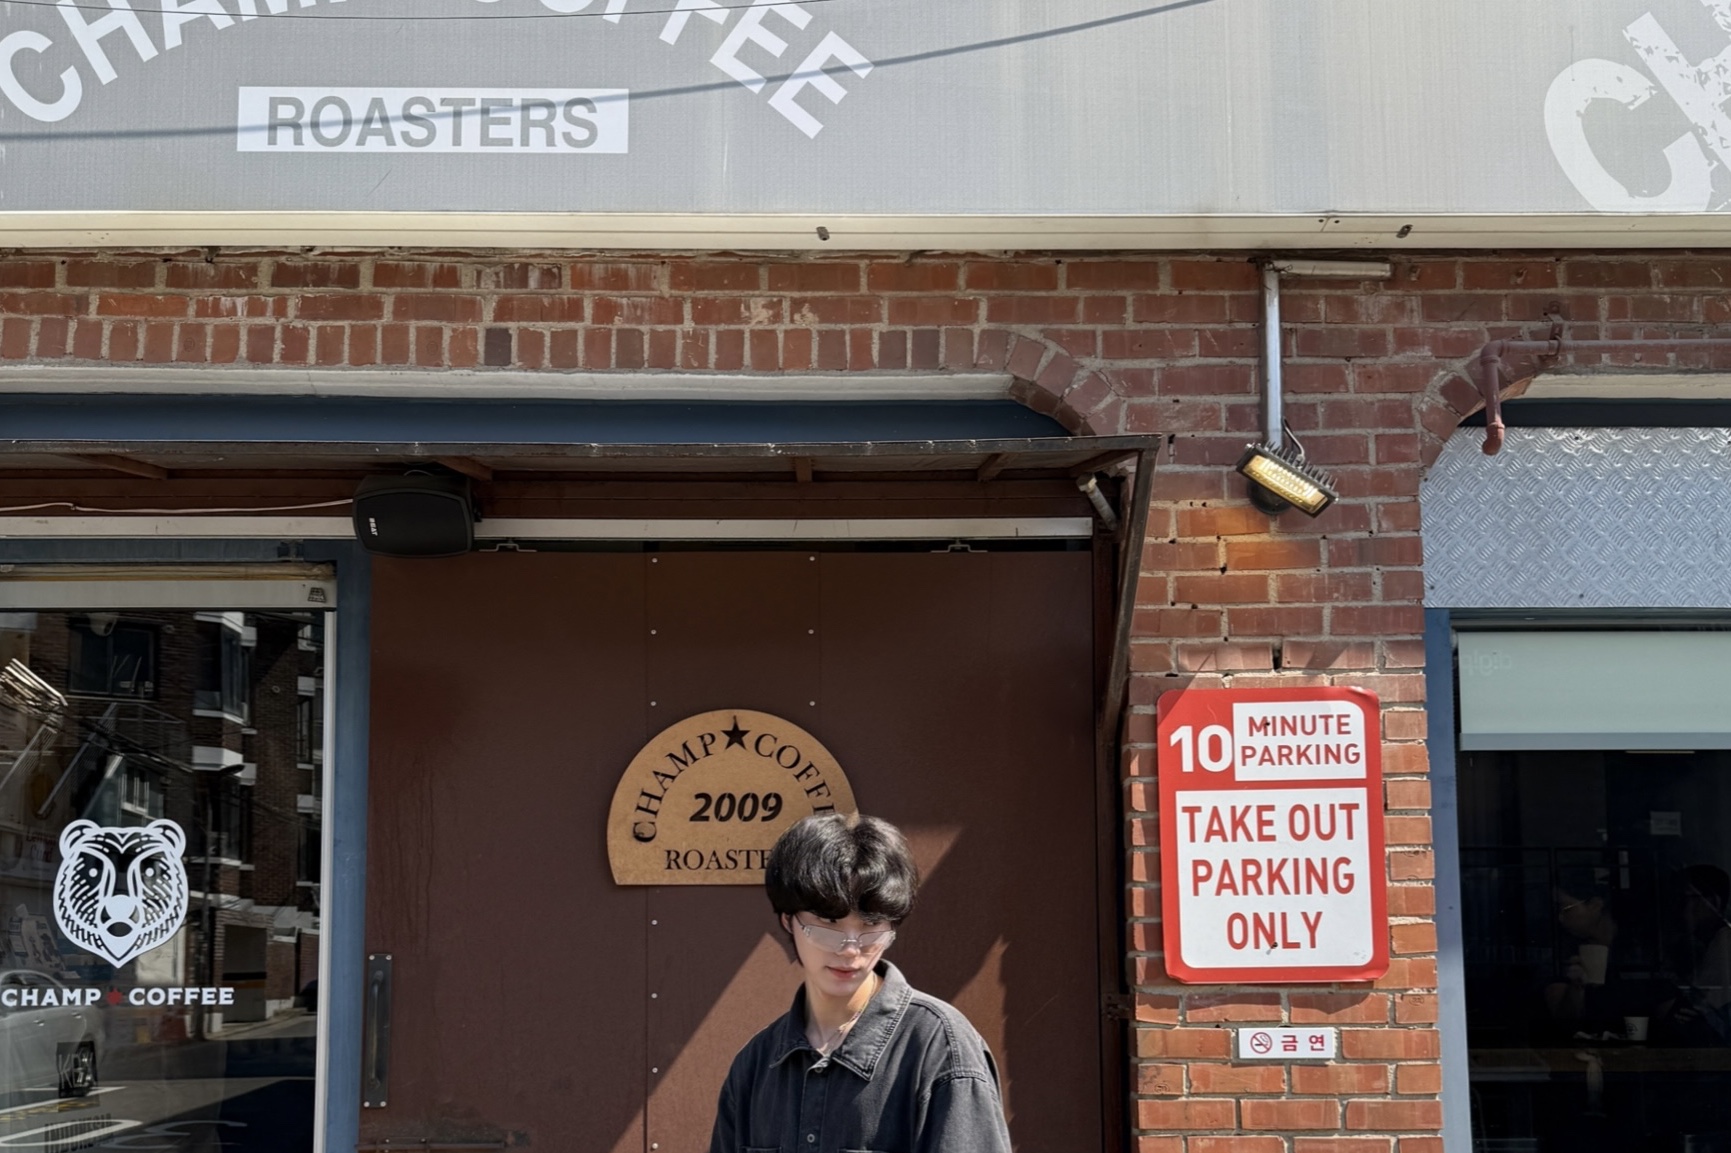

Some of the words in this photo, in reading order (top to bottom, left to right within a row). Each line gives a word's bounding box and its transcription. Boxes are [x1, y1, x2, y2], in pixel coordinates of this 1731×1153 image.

[0, 0, 348, 122] CHA
[267, 96, 599, 149] ROASTERS
[1248, 714, 1351, 737] MINUTE
[1169, 724, 1234, 772] 10
[1241, 743, 1361, 766] PARKING
[632, 732, 717, 843] CHAMP
[754, 733, 836, 815] COFF
[689, 792, 783, 822] 2009
[1182, 805, 1277, 842] TAKE
[1288, 803, 1360, 841] OUT
[665, 849, 771, 871] ROASTE
[1191, 857, 1355, 896] PARKING
[1227, 911, 1323, 950] ONLY
[1, 988, 101, 1006] CHAMP
[129, 987, 235, 1005] COFFEE
[1281, 1034, 1325, 1052] 금연
